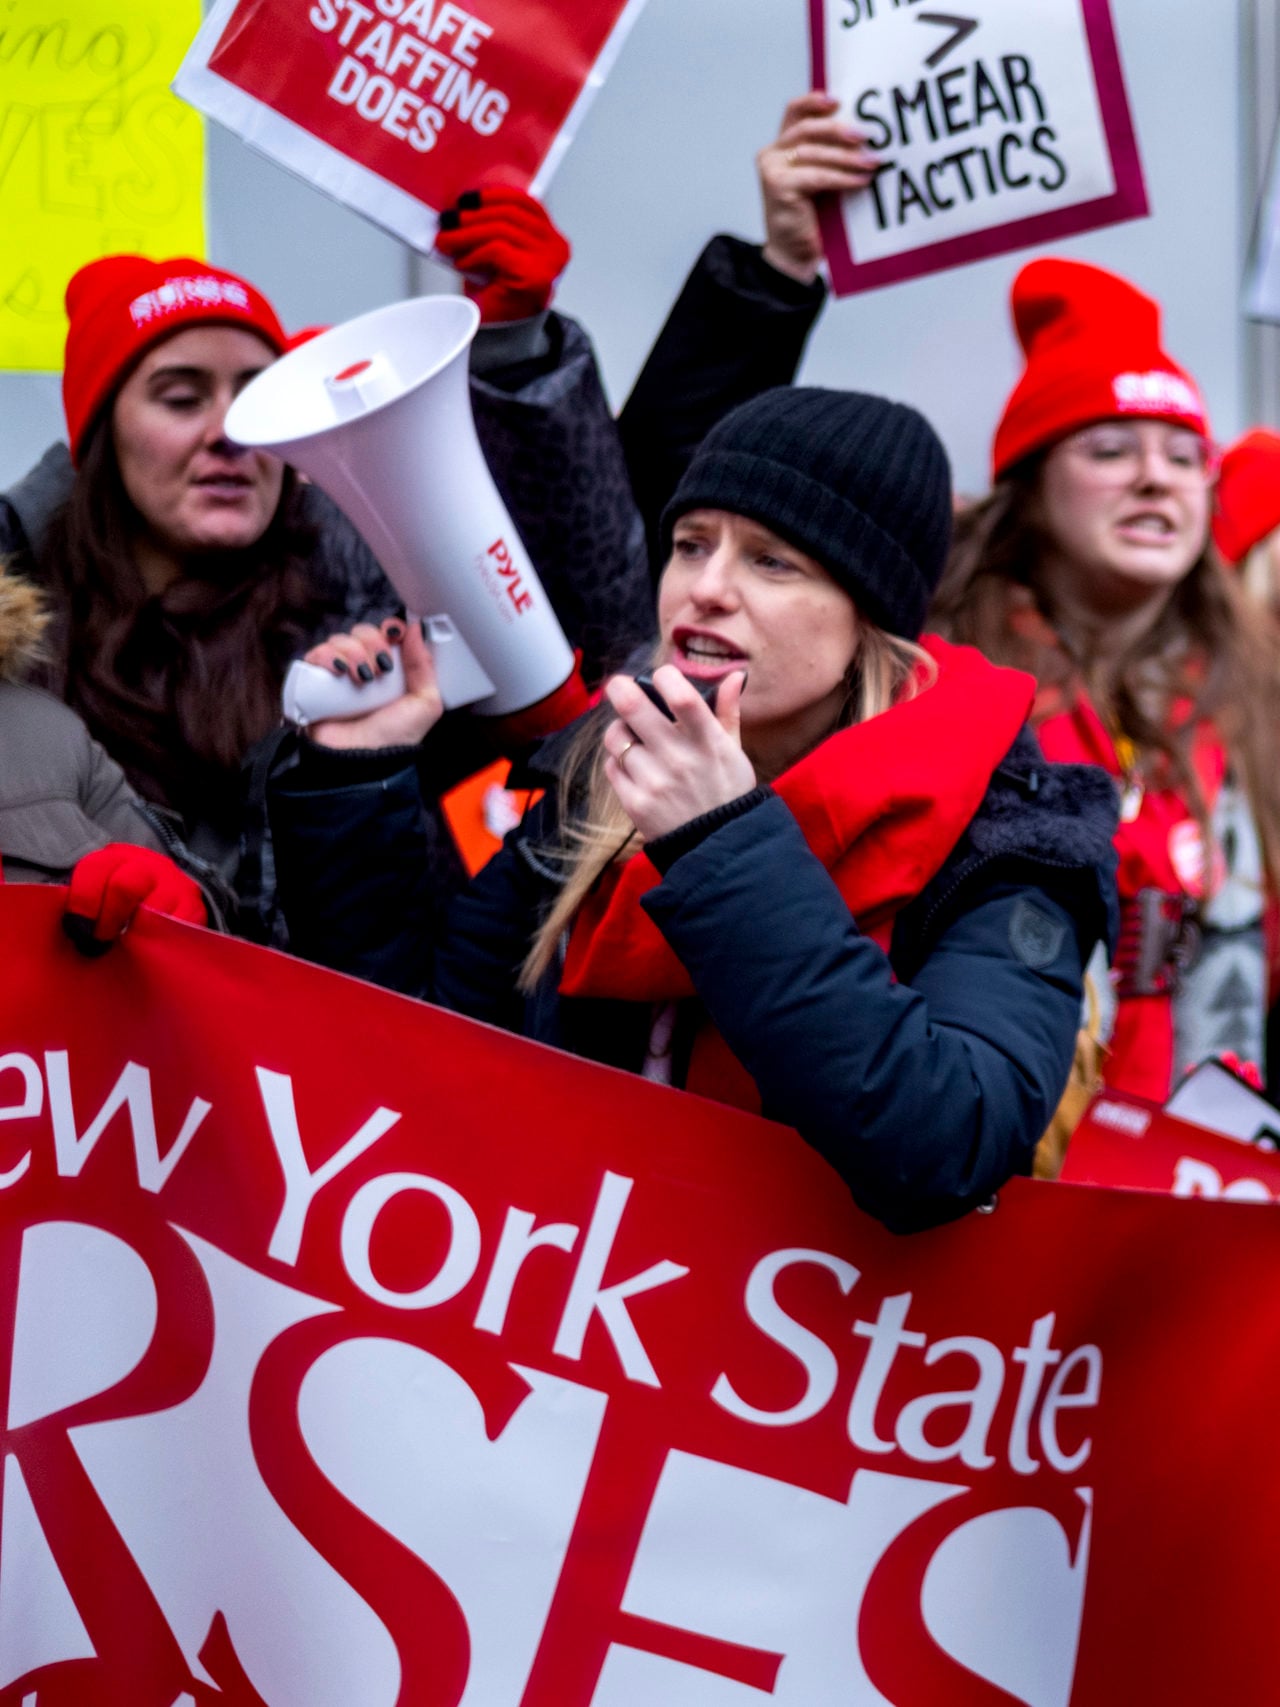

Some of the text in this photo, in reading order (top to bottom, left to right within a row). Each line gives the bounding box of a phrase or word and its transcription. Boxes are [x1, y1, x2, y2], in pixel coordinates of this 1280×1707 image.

[309, 0, 511, 137] STAFFING
[327, 55, 446, 153] DOES
[856, 53, 1046, 150] SMEAR
[868, 126, 1067, 230] TACTICS
[487, 537, 533, 616] PYLE
[255, 1065, 690, 1389] York
[709, 1247, 1103, 1476] State
